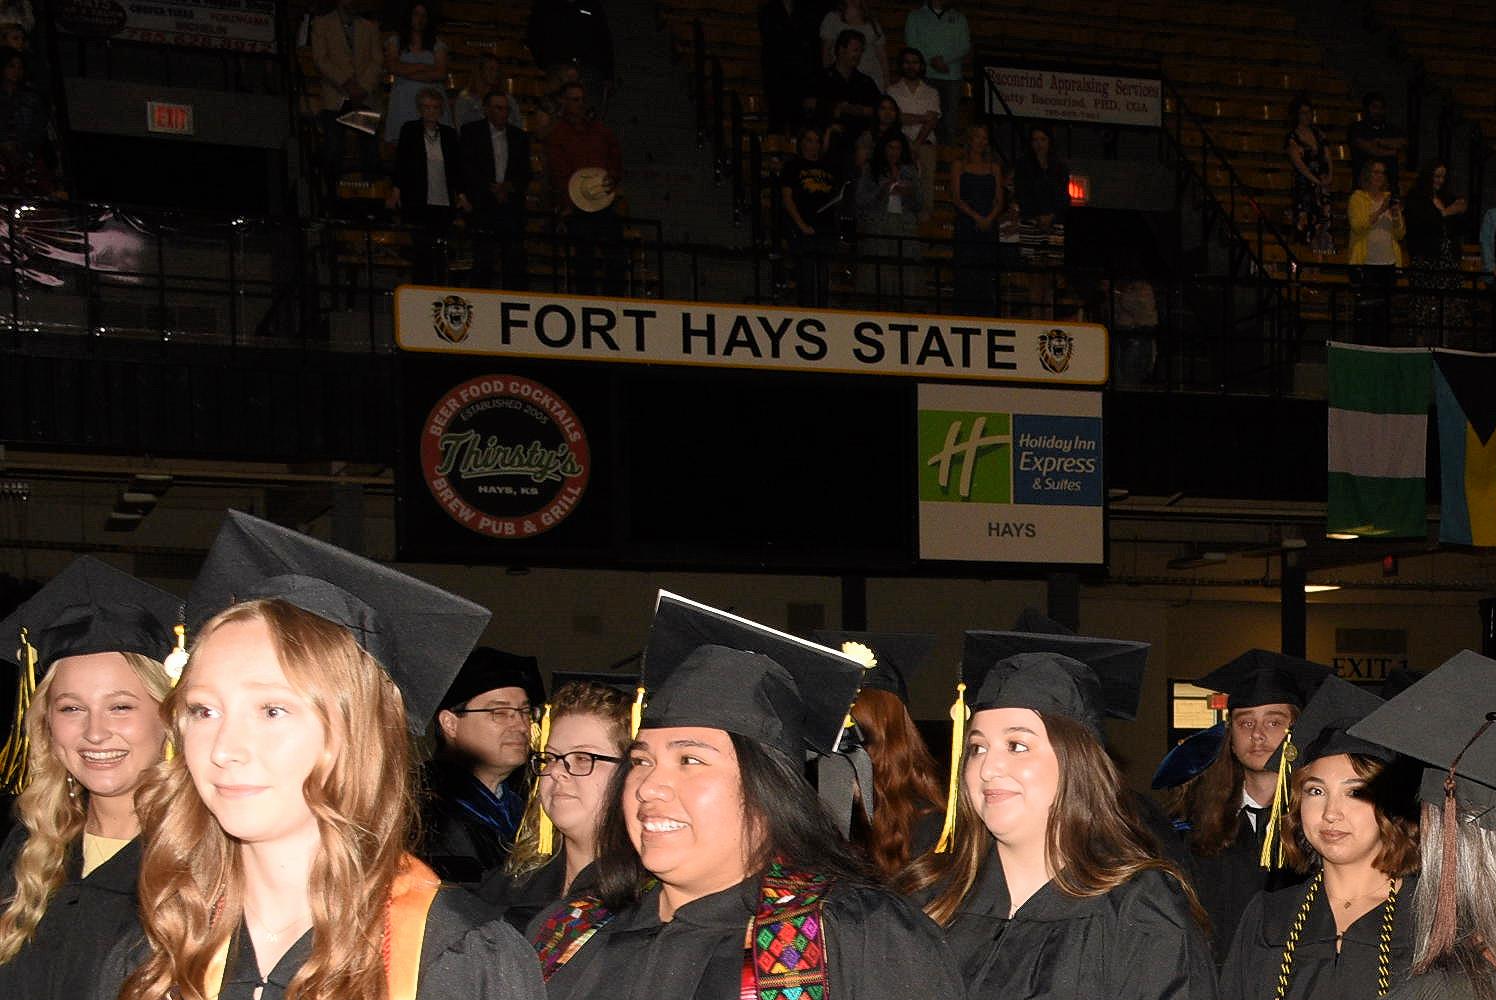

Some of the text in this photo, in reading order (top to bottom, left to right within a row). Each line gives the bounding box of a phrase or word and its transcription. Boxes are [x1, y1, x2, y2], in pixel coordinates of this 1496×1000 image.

[1050, 74, 1110, 98] Appraising
[1115, 79, 1160, 98] Services
[156, 105, 186, 129] EXIT
[501, 301, 1018, 370] FORT HAYS STATE
[429, 379, 582, 443] BEER FOOD COCKTAILS
[459, 398, 550, 425] ESTABLISHED 2005
[1018, 432, 1097, 453] Holiday Inn
[434, 429, 584, 483] Thirsty's
[1019, 451, 1097, 476] Express
[477, 485, 540, 496] HAYS, KS
[1031, 477, 1082, 492] & Suites
[431, 477, 583, 536] BREW PUB & GRILL
[987, 521, 1037, 538] HAYS
[1333, 657, 1393, 679] EXIT
